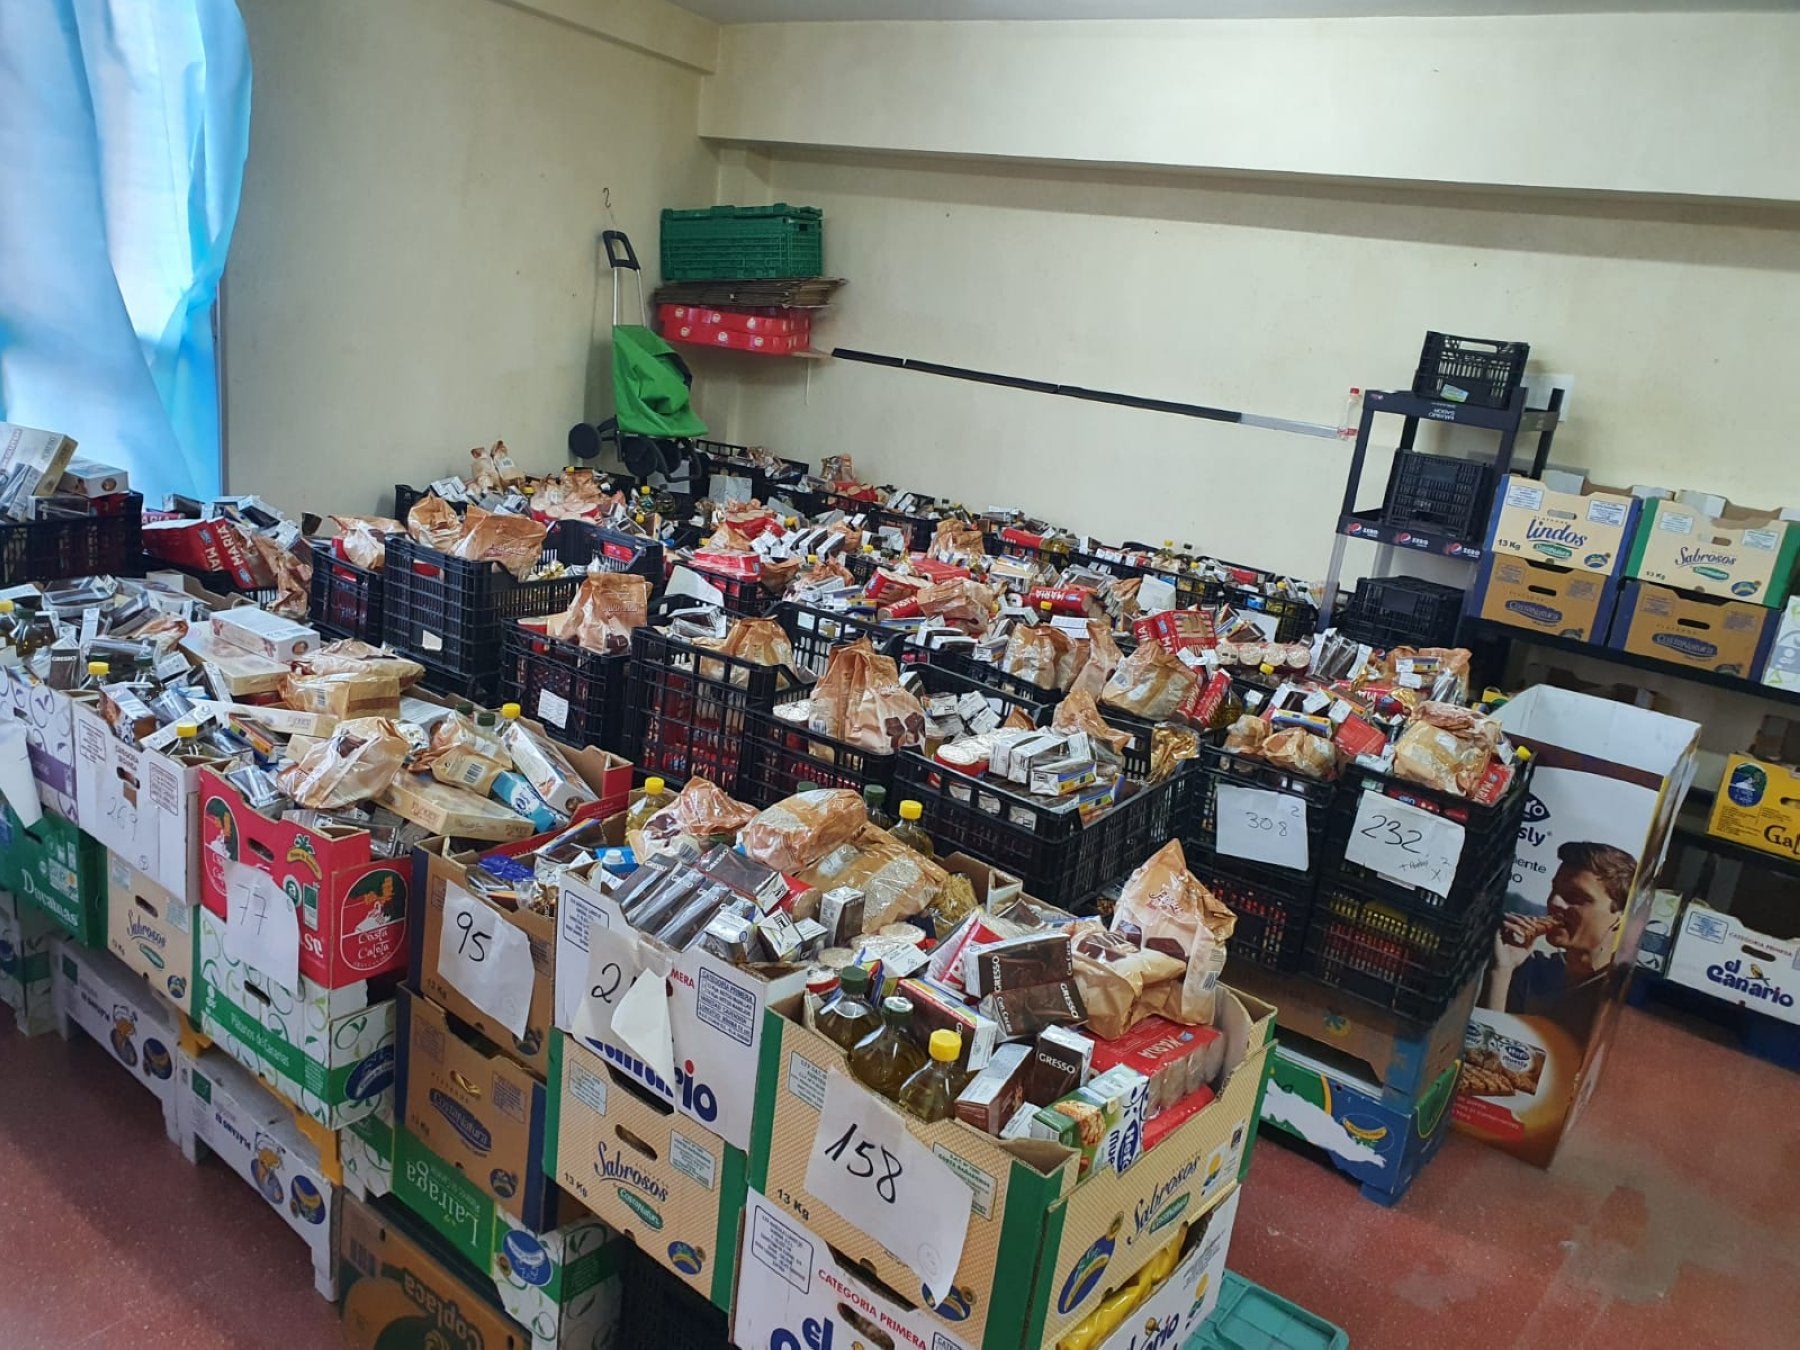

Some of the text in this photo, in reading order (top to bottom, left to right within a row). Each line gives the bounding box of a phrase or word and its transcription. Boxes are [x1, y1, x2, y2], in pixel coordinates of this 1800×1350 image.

[216, 524, 244, 566] MARIA
[1509, 541, 1521, 551] Kg
[1526, 518, 1588, 547] lindos
[1675, 547, 1736, 566] Sabrosos
[1245, 812, 1288, 837] 308
[1524, 799, 1545, 817] ro
[1360, 814, 1424, 854] 232
[1518, 827, 1546, 847] sly
[1514, 858, 1547, 874] ente
[235, 883, 268, 936] 77
[456, 911, 492, 962] 95
[591, 963, 634, 1004] 2
[671, 967, 695, 989] MERA
[992, 955, 1002, 992] GRESSO
[1724, 959, 1742, 975] el
[1060, 983, 1079, 1018] GRESSO
[1706, 964, 1795, 1008] Canario
[1039, 1053, 1076, 1074] GRESSO
[565, 1172, 575, 1185] 13
[594, 1141, 669, 1202] Sabrosos
[825, 1123, 903, 1204] 158
[406, 1160, 481, 1247] Lairaga
[776, 1188, 810, 1221] 13 Kg
[818, 1269, 927, 1350] CATEGORIA PRIMERA
